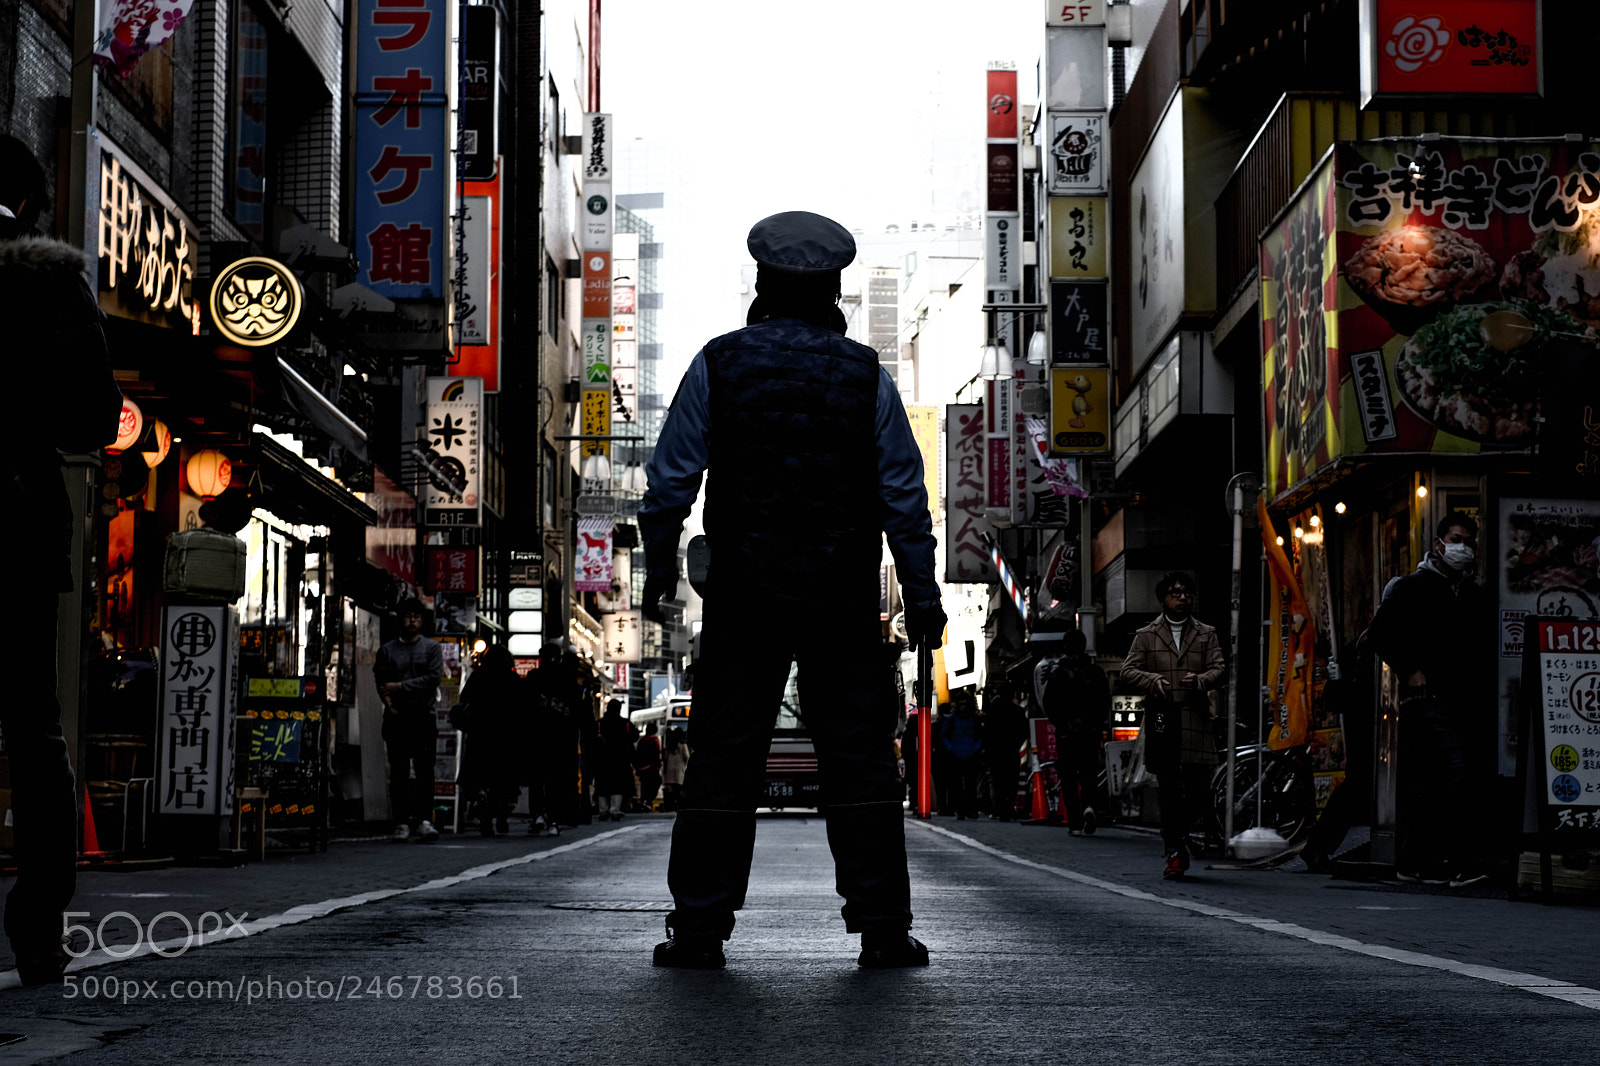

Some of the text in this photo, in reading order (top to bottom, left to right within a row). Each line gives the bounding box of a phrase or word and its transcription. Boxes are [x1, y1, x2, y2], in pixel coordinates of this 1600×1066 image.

[1061, 6, 1092, 22] 5F
[1458, 25, 1517, 49] はなまる
[1063, 286, 1103, 351] 大戸屋
[1356, 355, 1390, 438] スタミナ
[1546, 672, 1571, 682] サーモン
[166, 612, 217, 809] 串カツ専門店
[1548, 698, 1568, 707] こはだ
